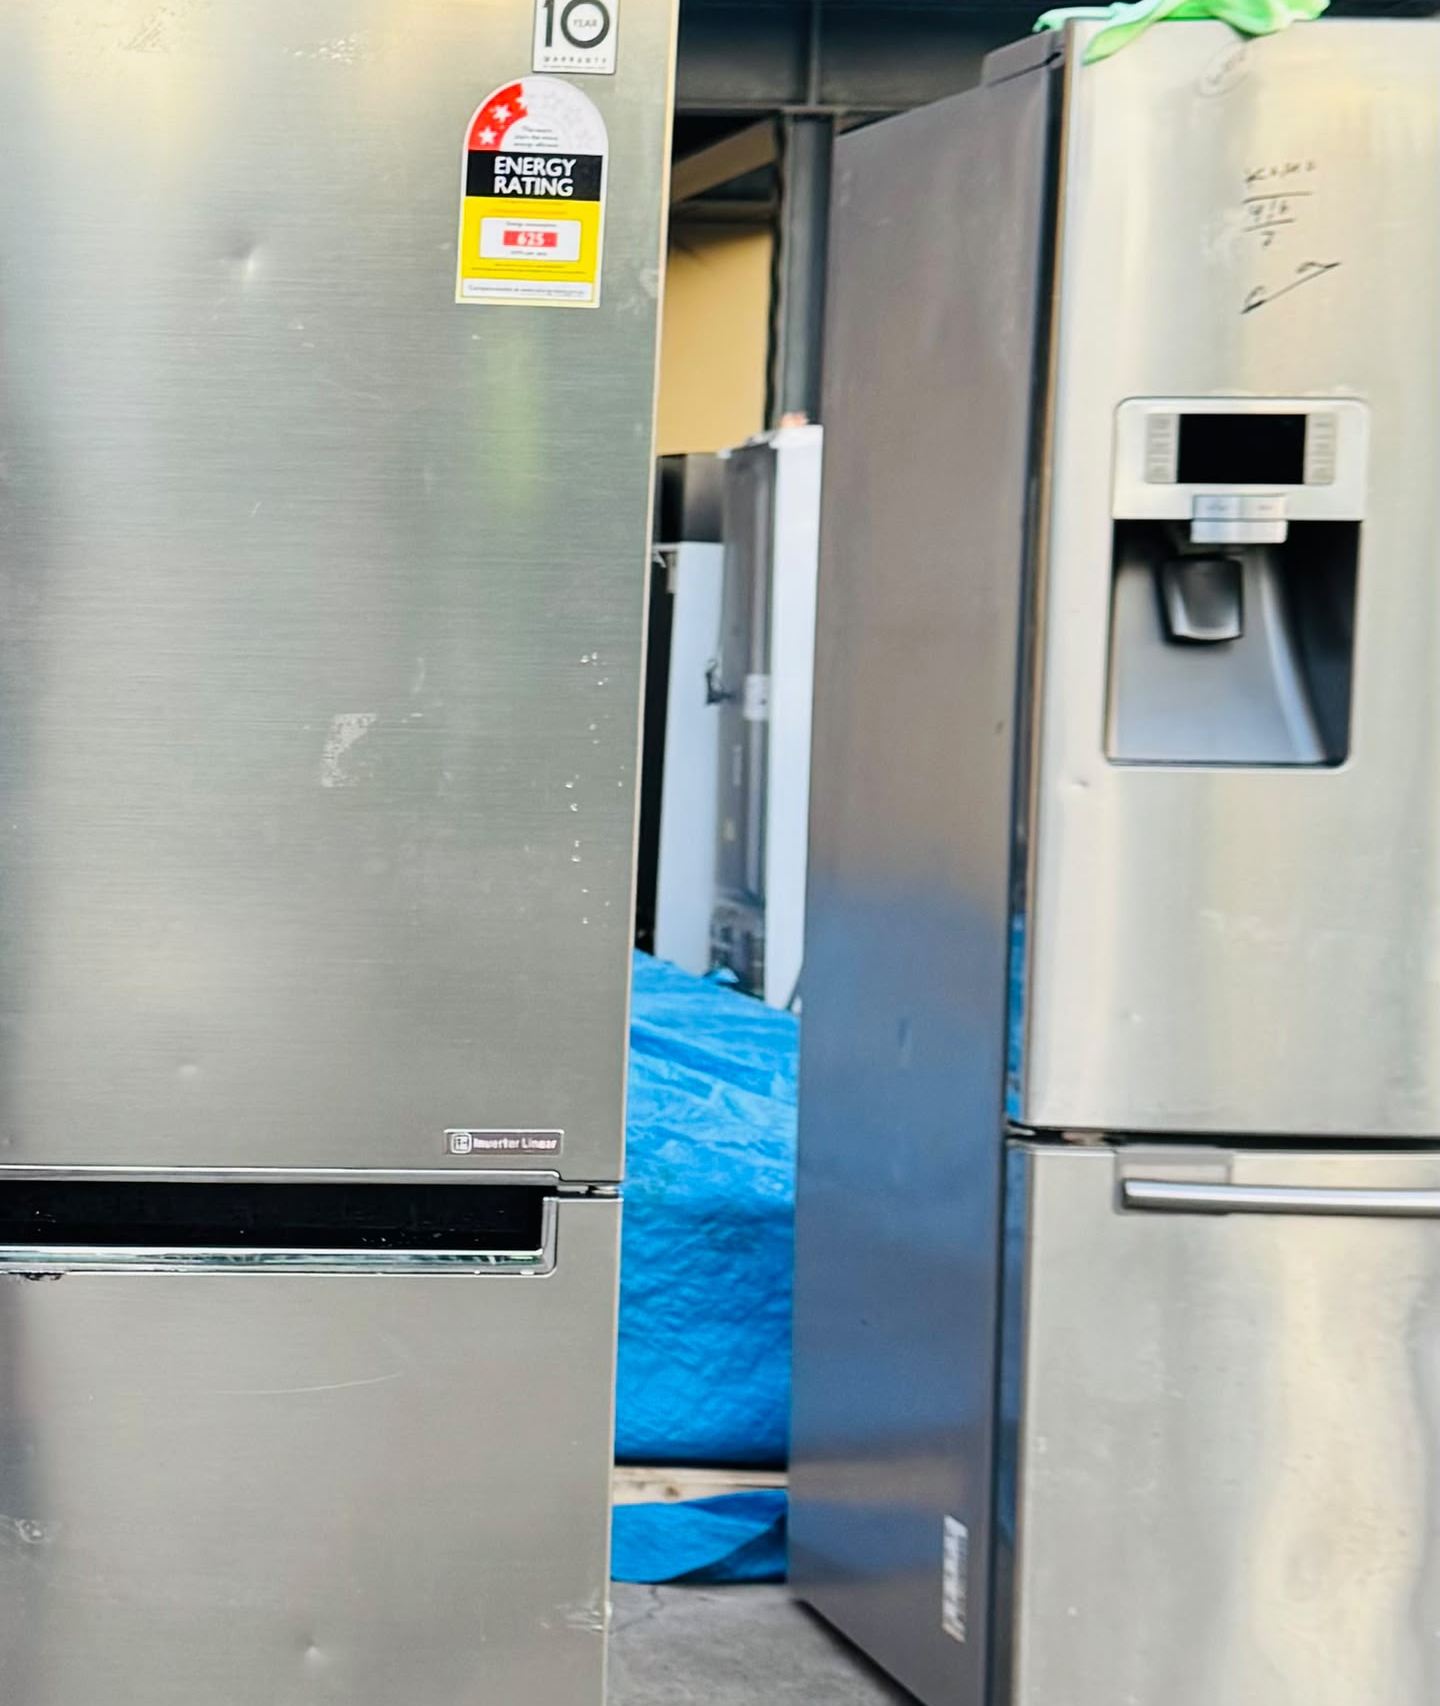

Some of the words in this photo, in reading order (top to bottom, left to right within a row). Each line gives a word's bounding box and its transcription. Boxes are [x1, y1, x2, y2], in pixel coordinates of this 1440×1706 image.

[493, 155, 577, 177] ENERGY
[493, 176, 574, 198] RATING
[516, 232, 545, 247] 625
